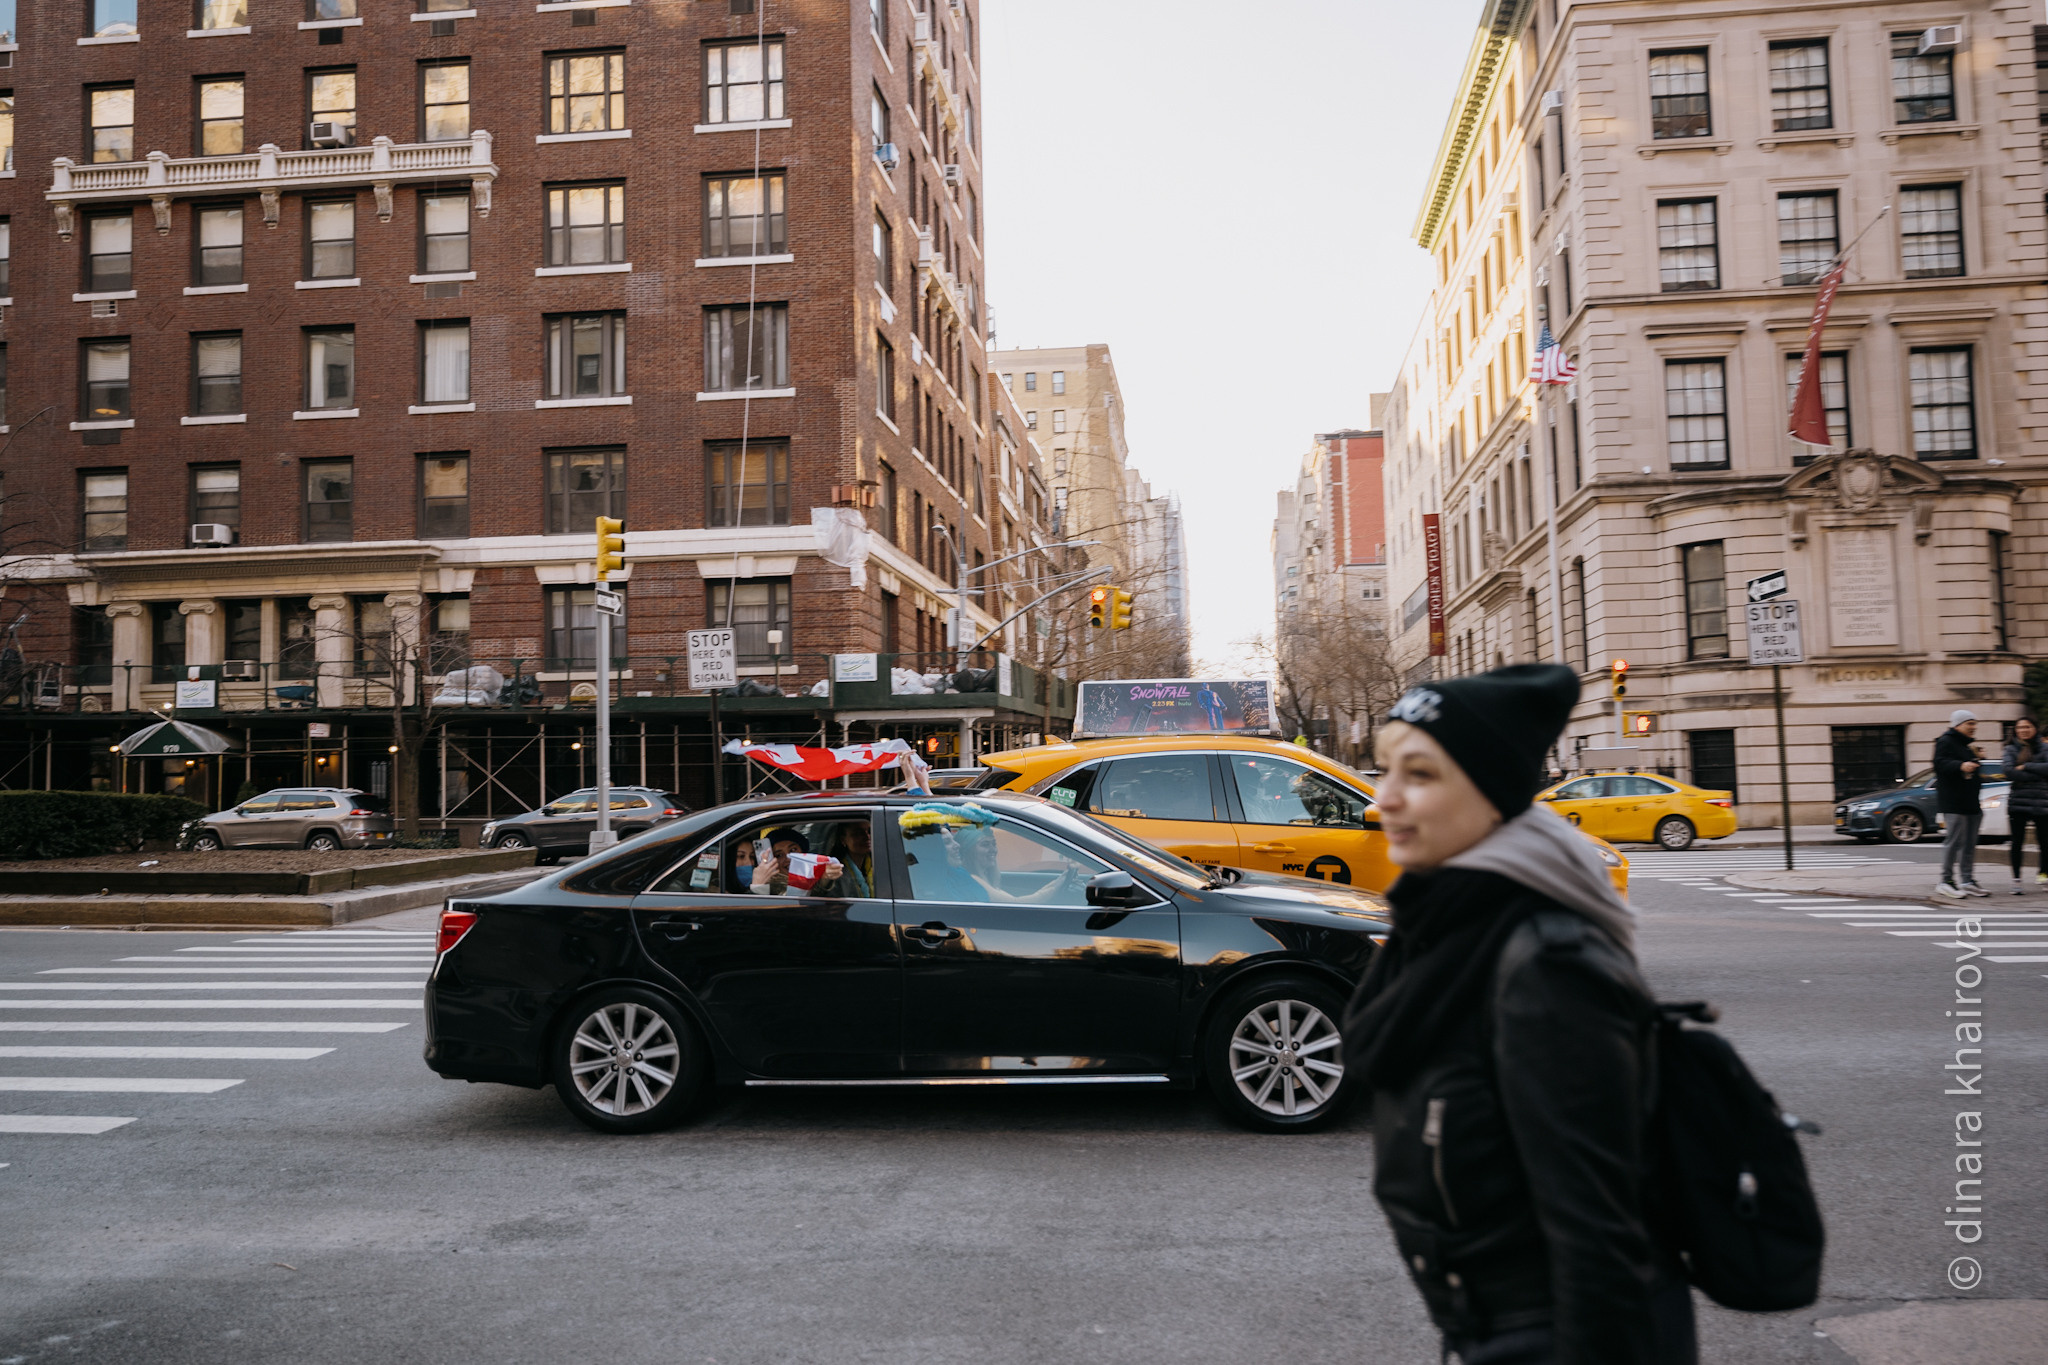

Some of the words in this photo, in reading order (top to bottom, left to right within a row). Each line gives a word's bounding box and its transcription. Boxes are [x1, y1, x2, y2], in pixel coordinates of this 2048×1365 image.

[1426, 525, 1440, 573] LOYOLA
[1429, 575, 1442, 624] SCHOOL
[1749, 604, 1796, 621] STOP
[1751, 623, 1778, 634] HERE
[691, 633, 731, 648] STOP
[1762, 635, 1788, 646] RED
[692, 649, 715, 660] HERE
[720, 649, 731, 658] ON
[1753, 648, 1799, 660] SIGNAL
[702, 661, 723, 671] RED
[694, 673, 733, 683] SIGNAL
[1130, 685, 1191, 701] SNOWFALL
[1052, 788, 1077, 799] curb
[1282, 863, 1304, 872] NYC
